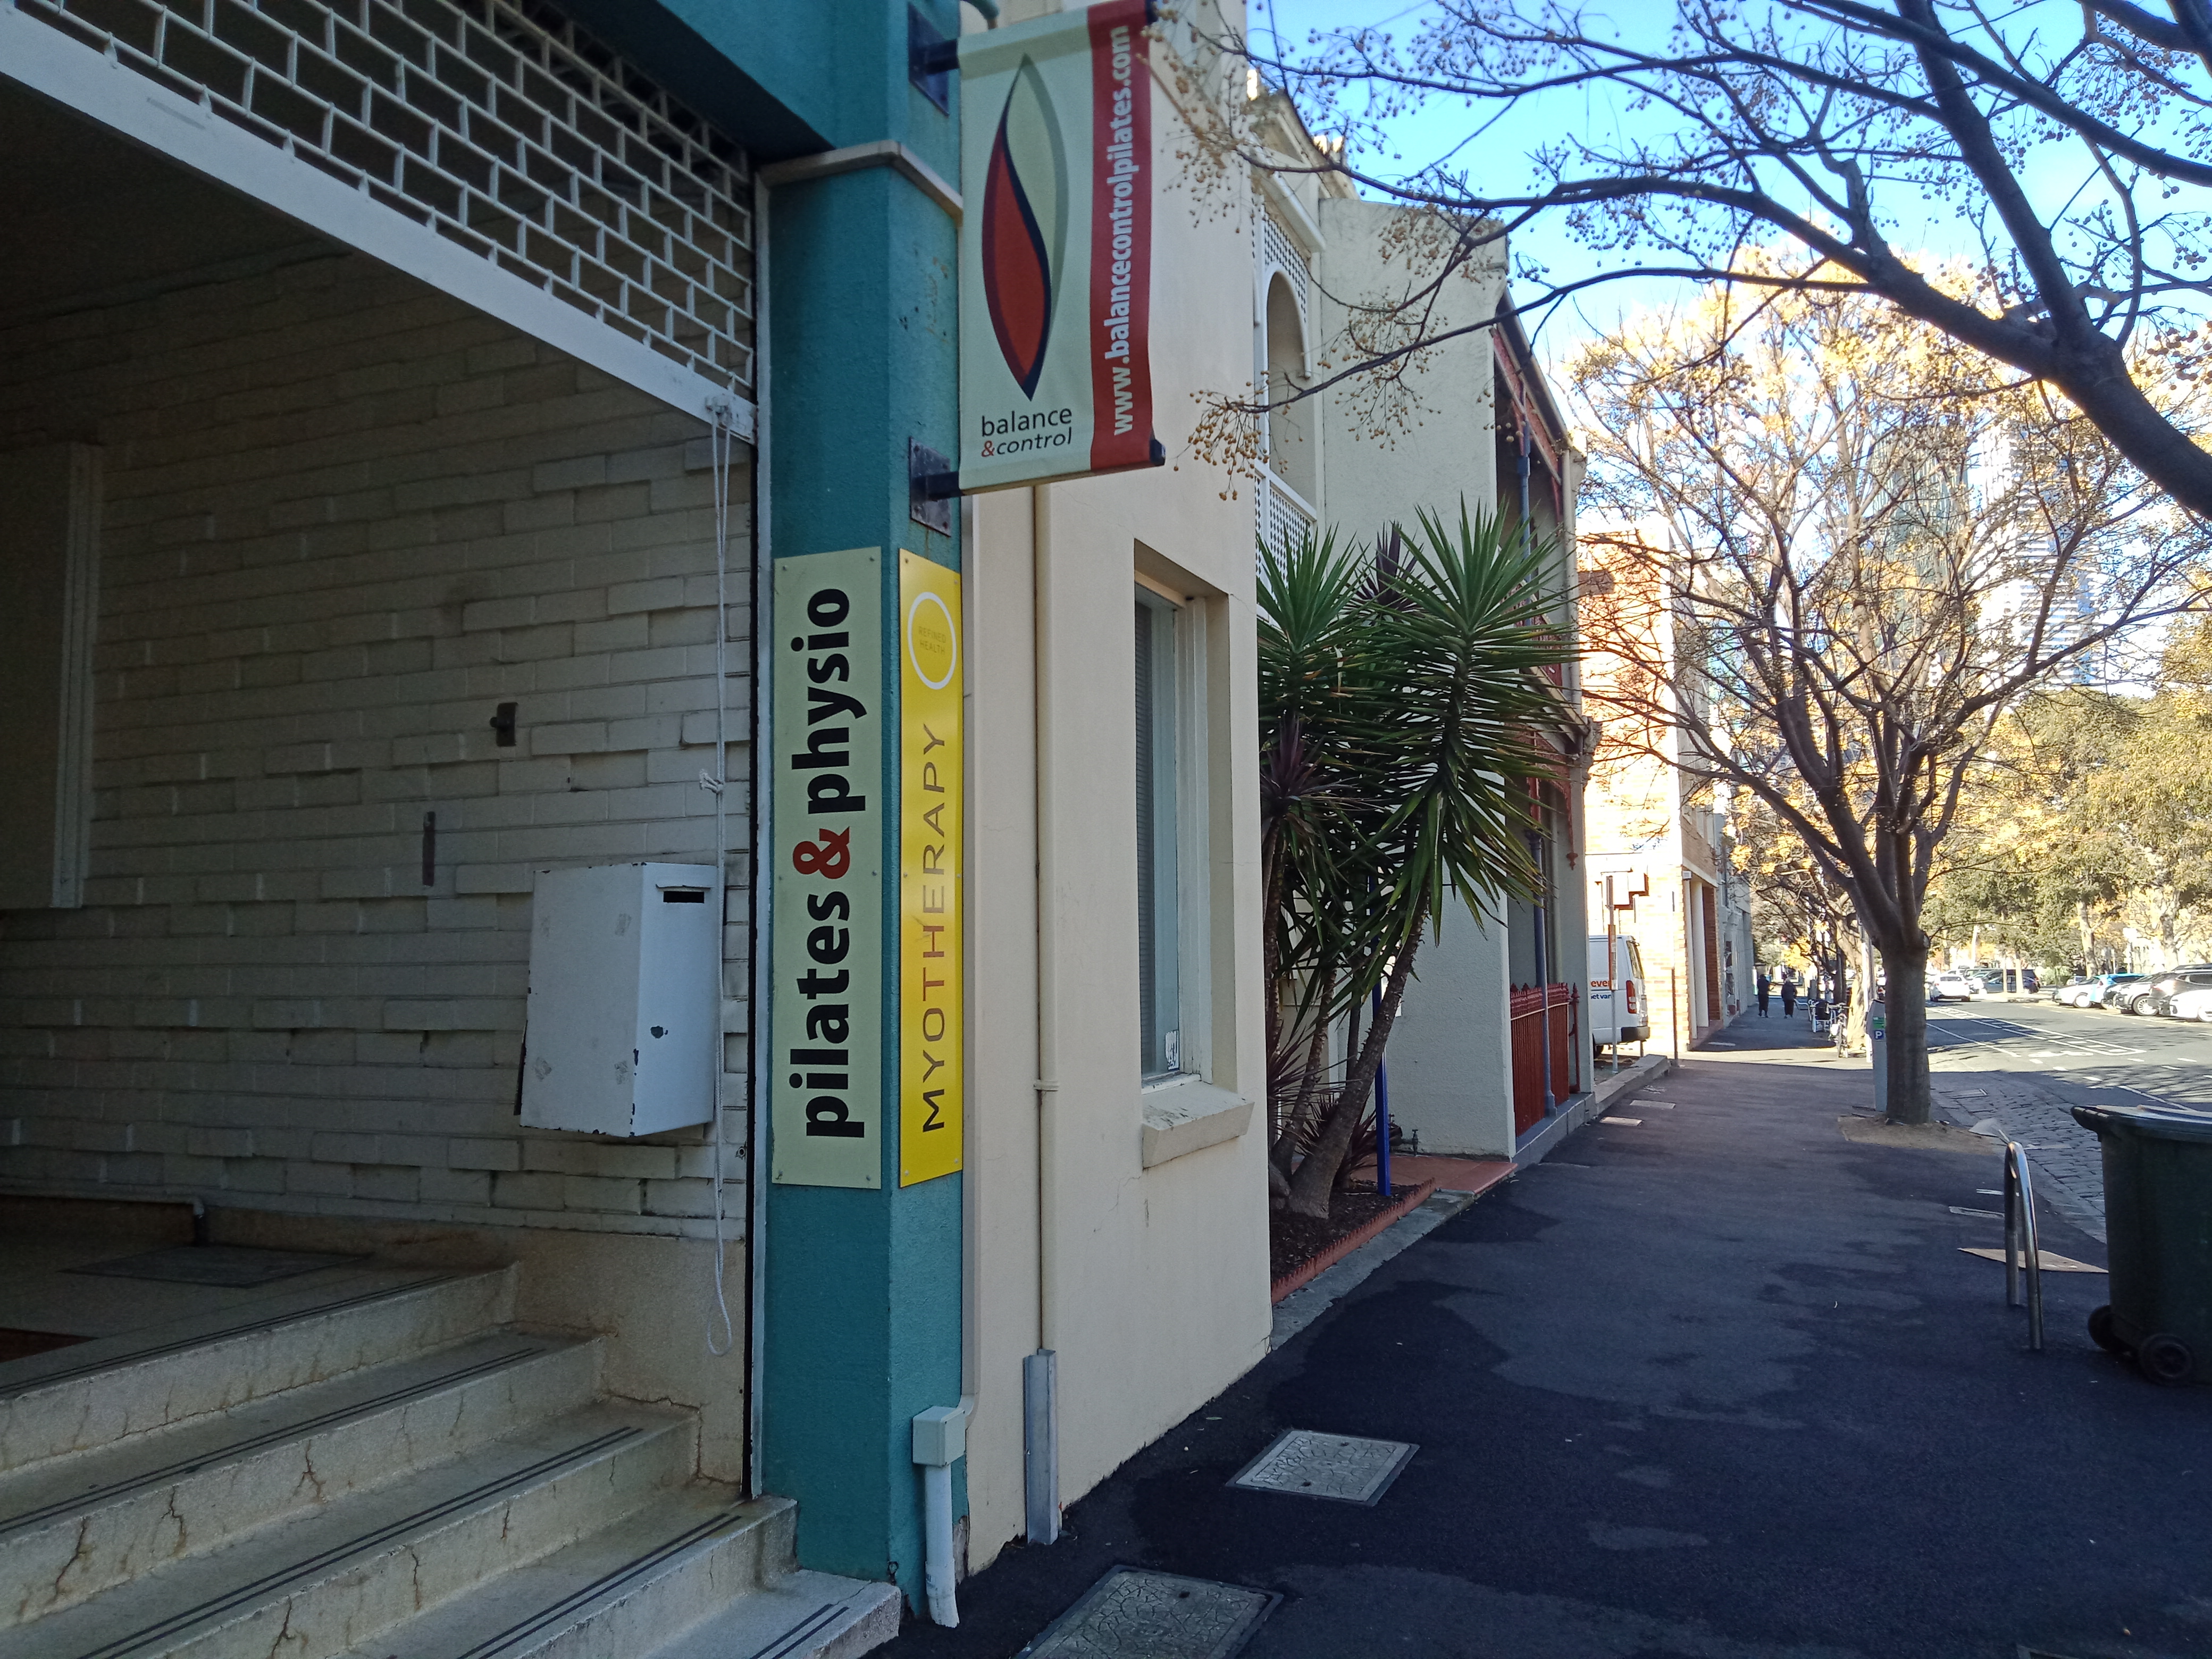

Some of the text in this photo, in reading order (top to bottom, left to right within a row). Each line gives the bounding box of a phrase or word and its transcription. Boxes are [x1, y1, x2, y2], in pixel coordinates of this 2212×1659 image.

[1104, 25, 1140, 435] www.balancecontrolpilates.com
[981, 427, 1072, 457] &control
[982, 408, 1072, 437] balance
[789, 588, 868, 1138] pilates & physio
[922, 723, 945, 1133] MYOTHERAPY
[1875, 1030, 1882, 1039] P
